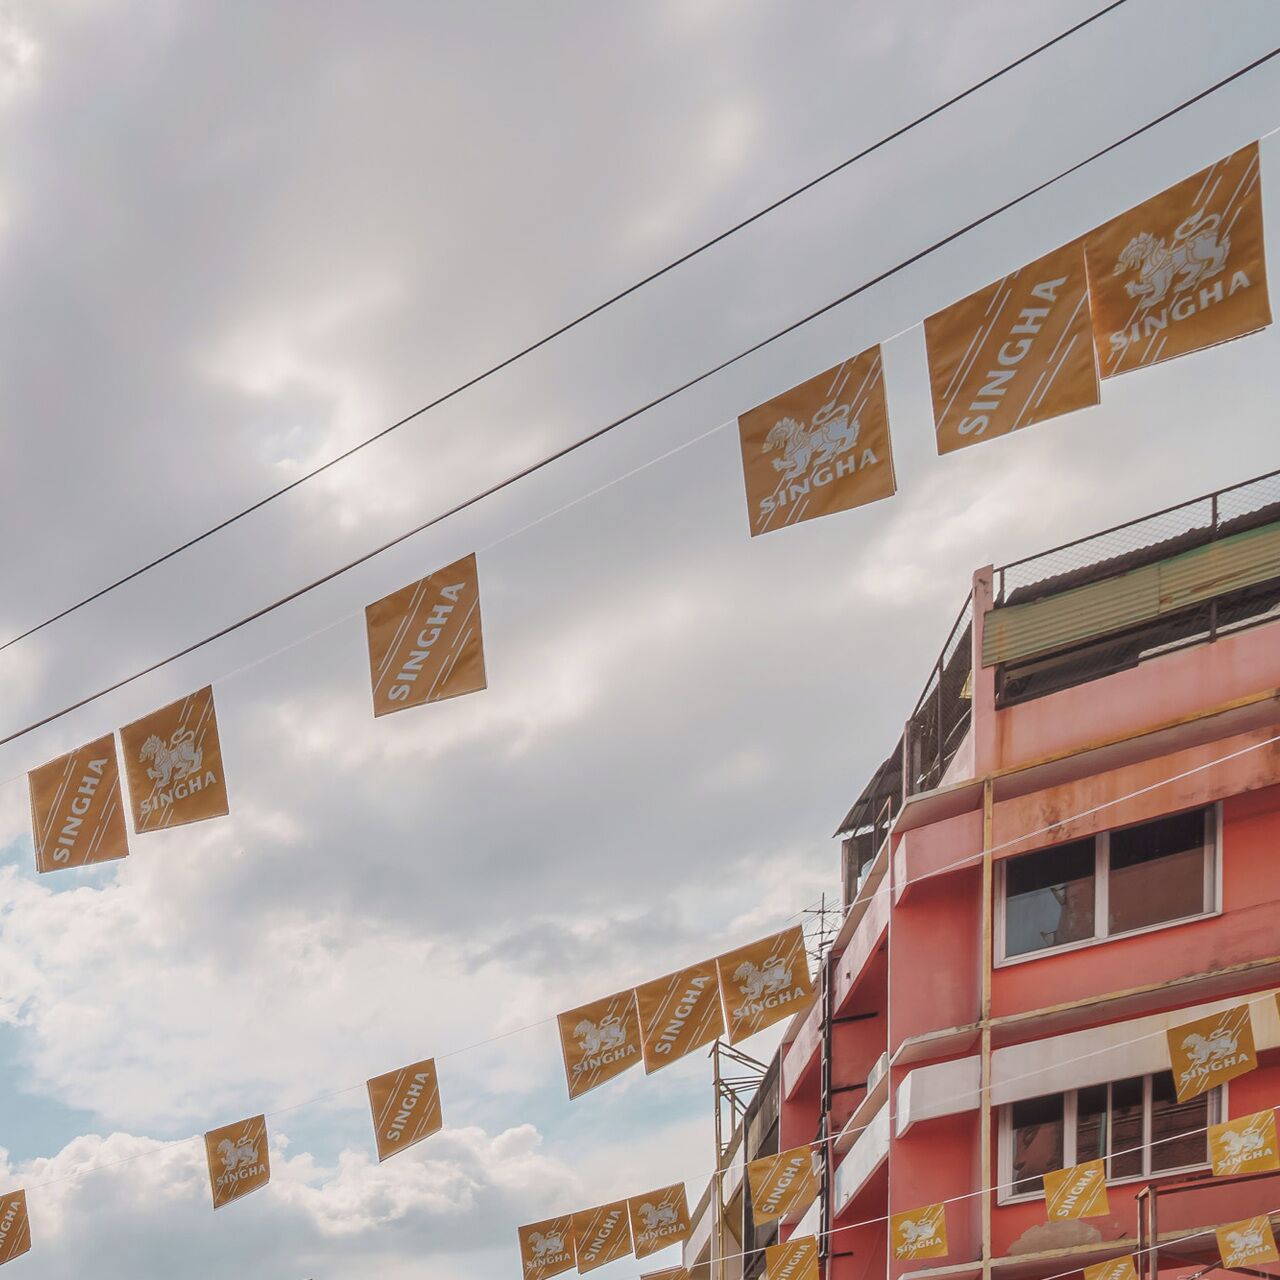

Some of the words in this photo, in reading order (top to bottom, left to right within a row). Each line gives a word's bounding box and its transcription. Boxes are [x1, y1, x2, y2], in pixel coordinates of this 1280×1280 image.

[1109, 269, 1251, 352] SINGHA
[959, 276, 1068, 437] SINGHA
[758, 446, 878, 517] SINGHA
[388, 581, 465, 703] SINGHA
[52, 757, 109, 863] SINGHA
[140, 771, 217, 816] SINGHA
[655, 973, 709, 1056] SINGHA
[731, 984, 807, 1021] SINGHA
[572, 1041, 637, 1077] SINGHA
[1180, 1052, 1250, 1083] SINGHA
[216, 1164, 267, 1187] SINGHA
[1217, 1146, 1273, 1170] SINGHA
[762, 1162, 808, 1218] SINGHA
[1056, 1166, 1100, 1219] SINGHA
[583, 1208, 622, 1262] SINGHA
[637, 1223, 686, 1243] SINGHA
[897, 1236, 943, 1255] SINGHA
[1226, 1243, 1271, 1264] SINGHA
[526, 1252, 571, 1270] SINGHA
